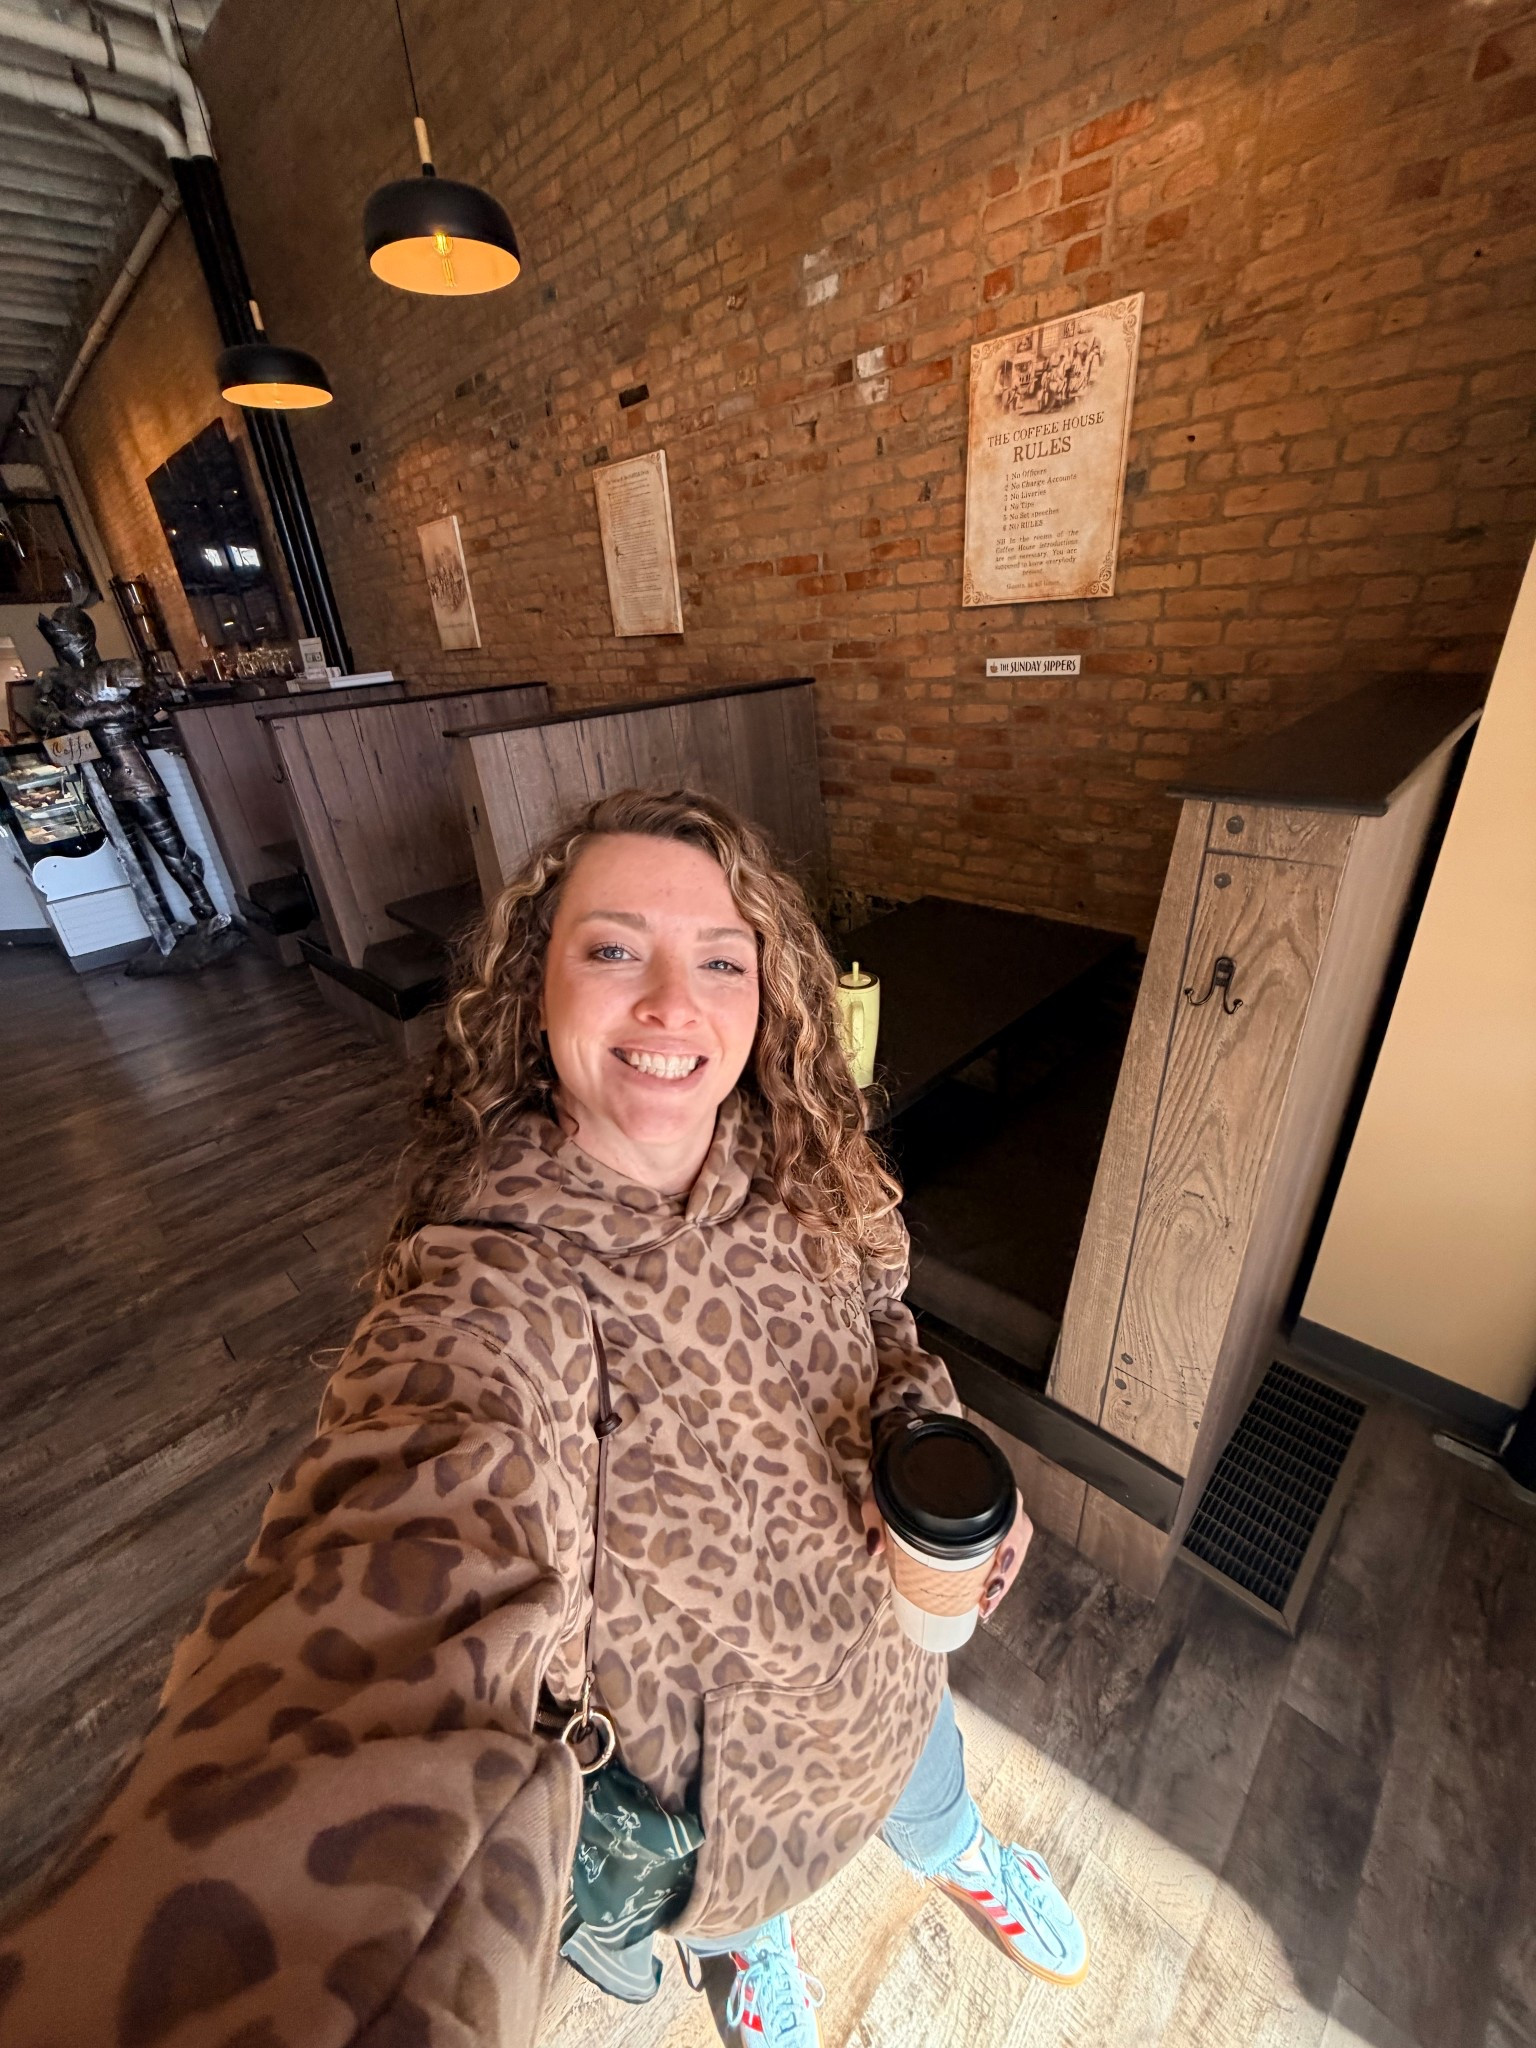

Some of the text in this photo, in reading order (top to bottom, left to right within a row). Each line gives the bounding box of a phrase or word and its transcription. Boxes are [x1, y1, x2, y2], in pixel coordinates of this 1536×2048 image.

[988, 411, 1105, 447] THE COFFEE HOUSE
[1013, 436, 1071, 463] RULES
[1011, 472, 1020, 480] No
[1011, 482, 1020, 490] No
[1021, 479, 1045, 489] Charge
[1046, 473, 1078, 484] Accounts
[1010, 493, 1019, 501] No
[1010, 503, 1019, 511] No
[1009, 513, 1019, 521] No
[1009, 523, 1020, 531] NO
[1020, 520, 1044, 529] RULES
[1056, 530, 1064, 538] of
[1018, 544, 1036, 552] House
[1000, 659, 1076, 674] THE SUNDAY SIPPERS
[52, 735, 92, 761] Coffee
